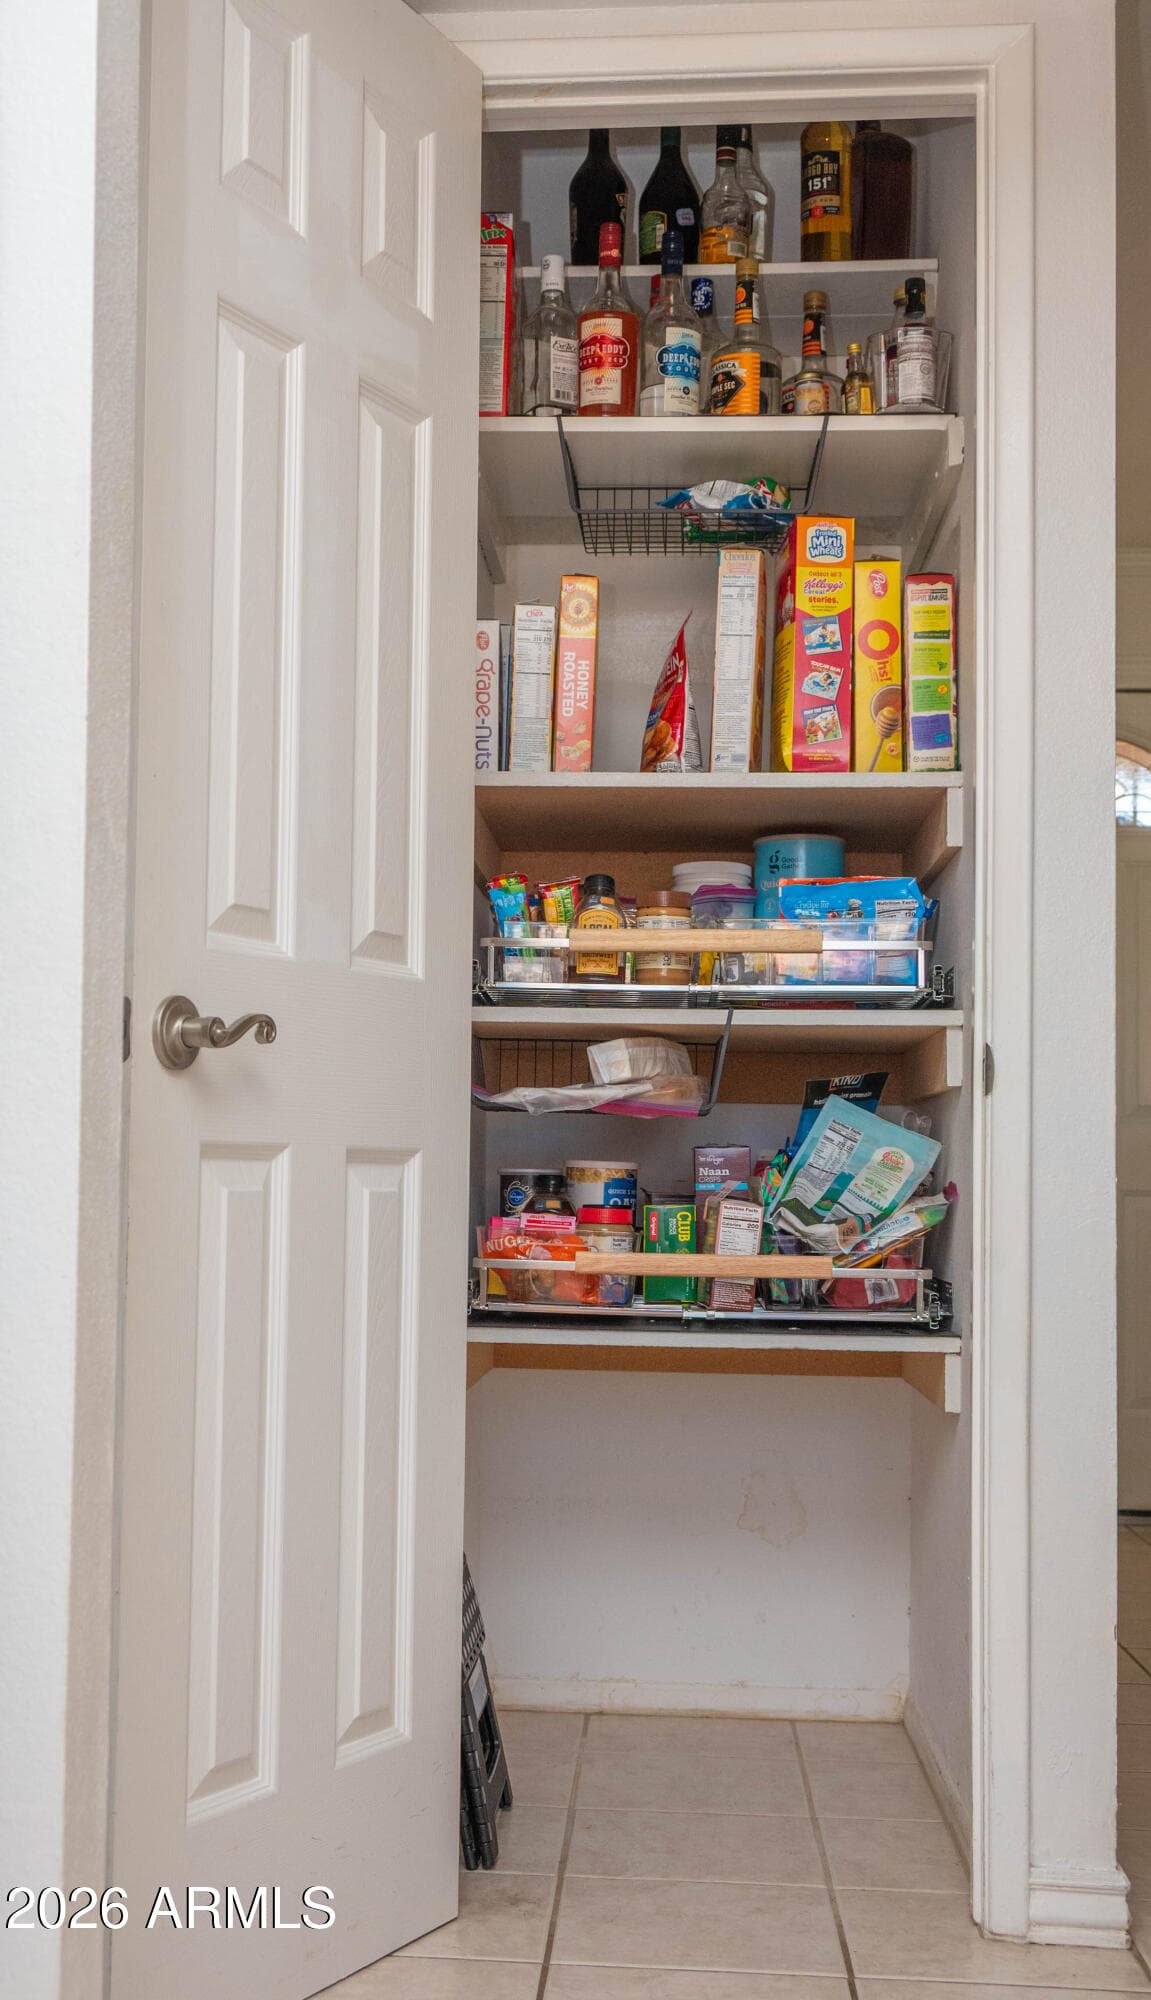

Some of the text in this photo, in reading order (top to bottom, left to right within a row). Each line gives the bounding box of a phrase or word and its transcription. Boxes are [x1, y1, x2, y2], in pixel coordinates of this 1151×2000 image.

[480, 225, 506, 242] Trix
[602, 344, 624, 355] EDDY
[662, 352, 684, 363] DEEP
[723, 381, 736, 390] SEC
[812, 536, 841, 547] Mini
[810, 546, 842, 557] Wheats
[804, 578, 843, 592] Kellogg's
[871, 572, 886, 596] Post
[562, 651, 576, 718] ROASTED
[576, 660, 590, 710] HONEY
[698, 1167, 730, 1176] Naan
[676, 1211, 692, 1242] CLUB
